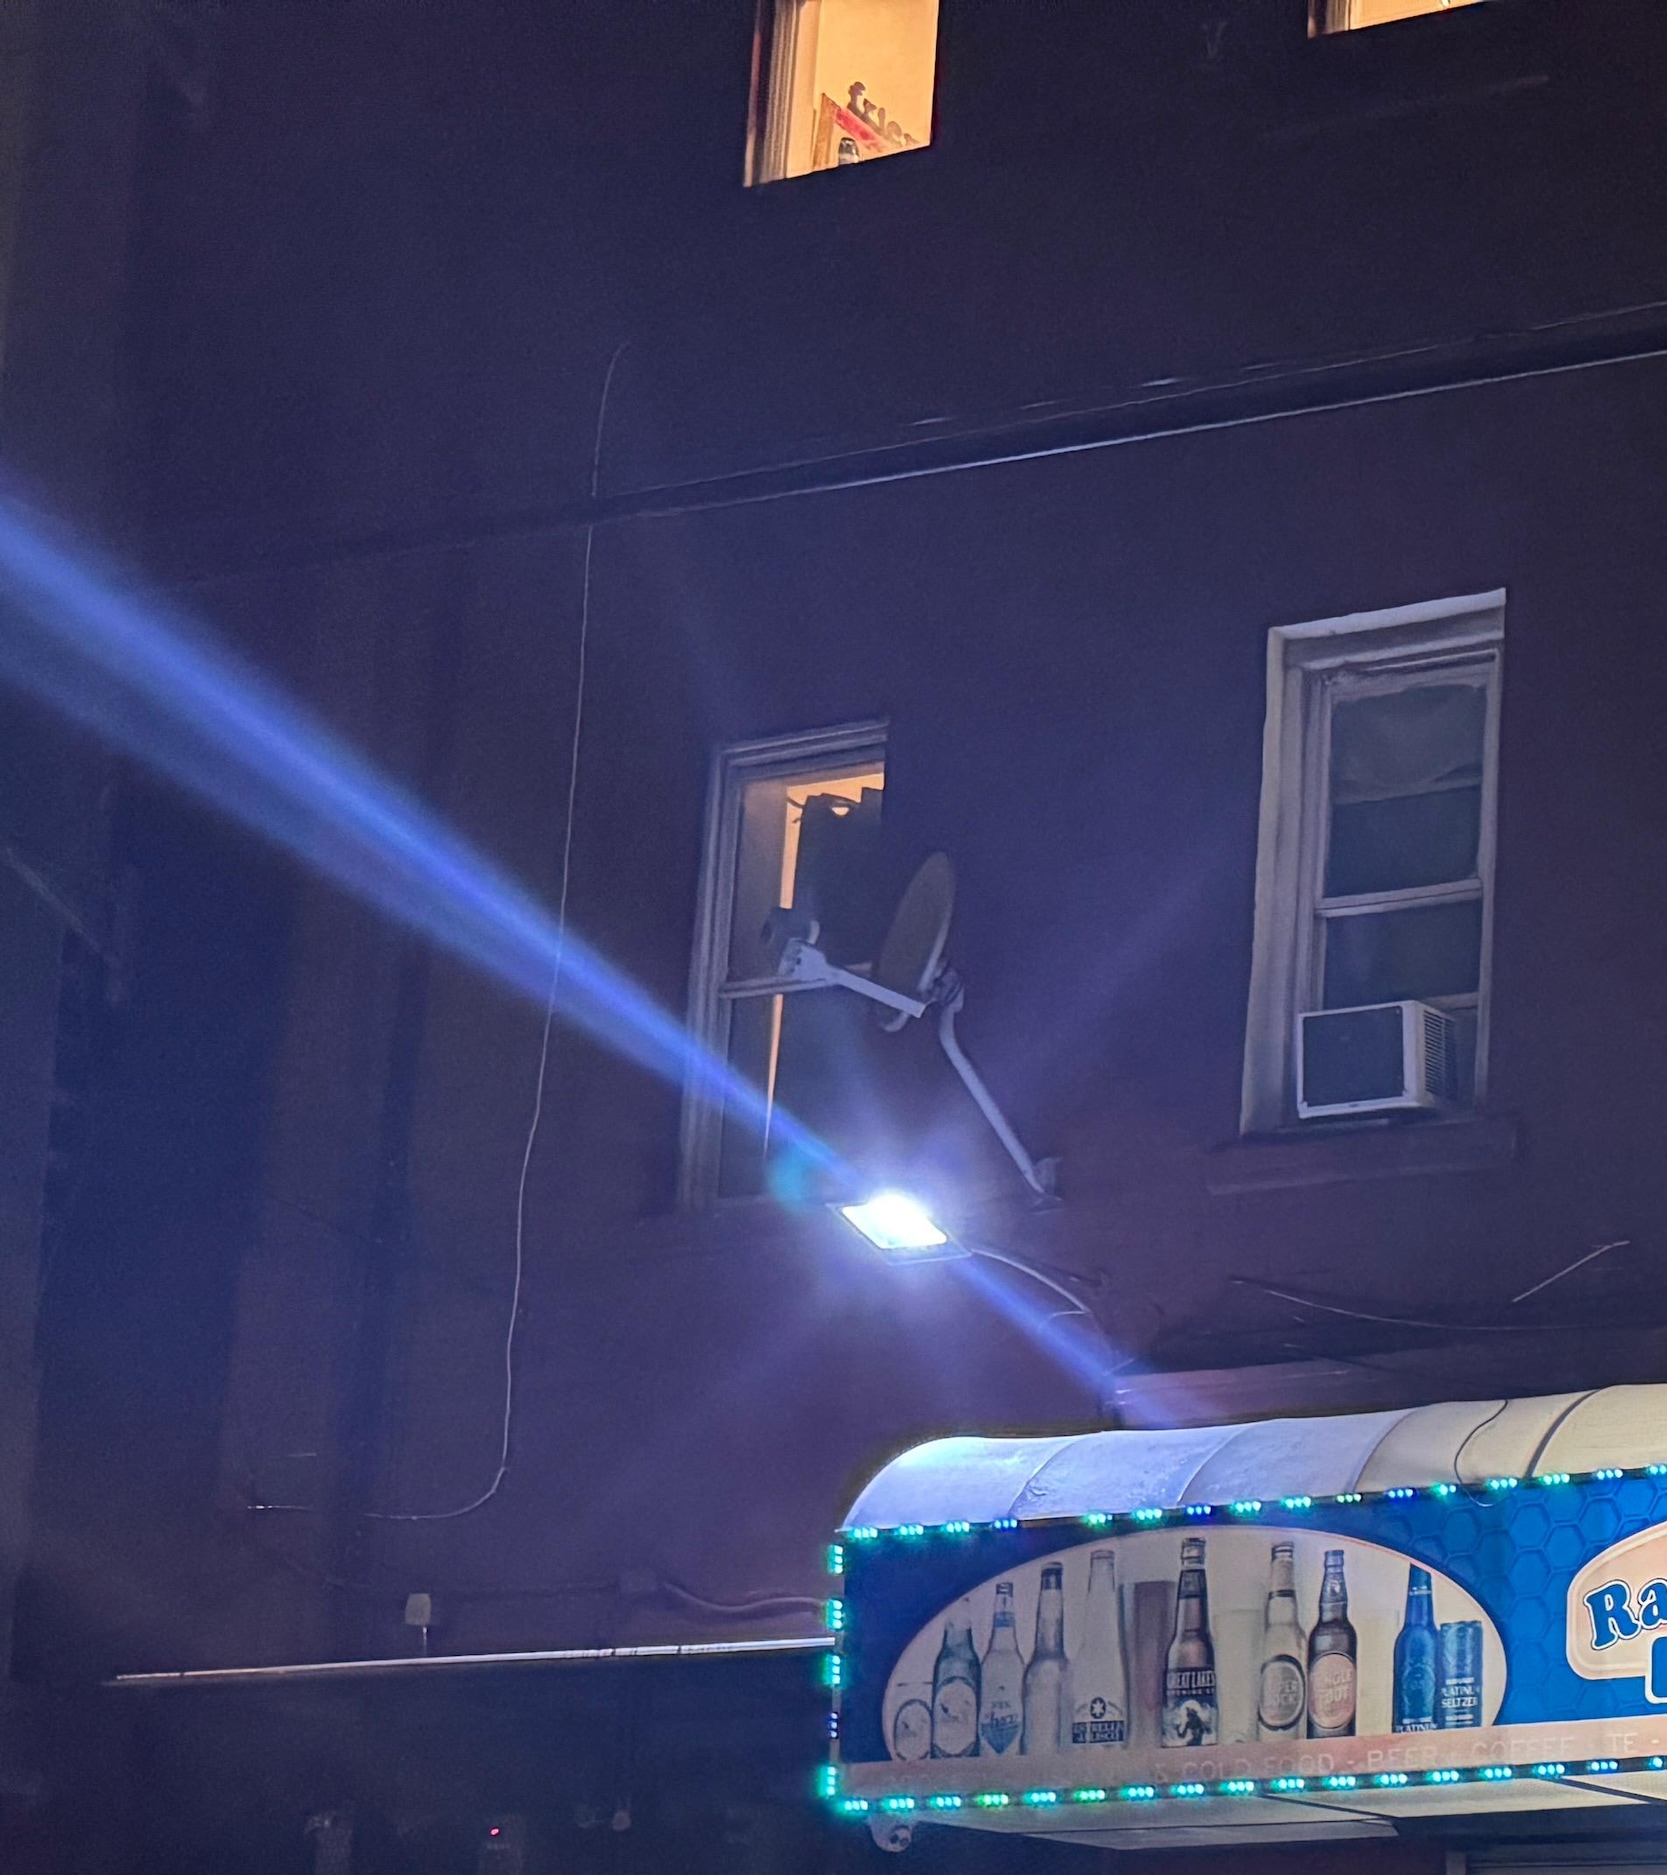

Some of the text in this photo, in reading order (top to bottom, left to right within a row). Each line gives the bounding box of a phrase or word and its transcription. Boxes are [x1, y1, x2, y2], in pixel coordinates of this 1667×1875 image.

[1264, 1753, 1335, 1776] FOOD
[1366, 1745, 1438, 1770] BEER
[1472, 1735, 1575, 1759] COFFEE
